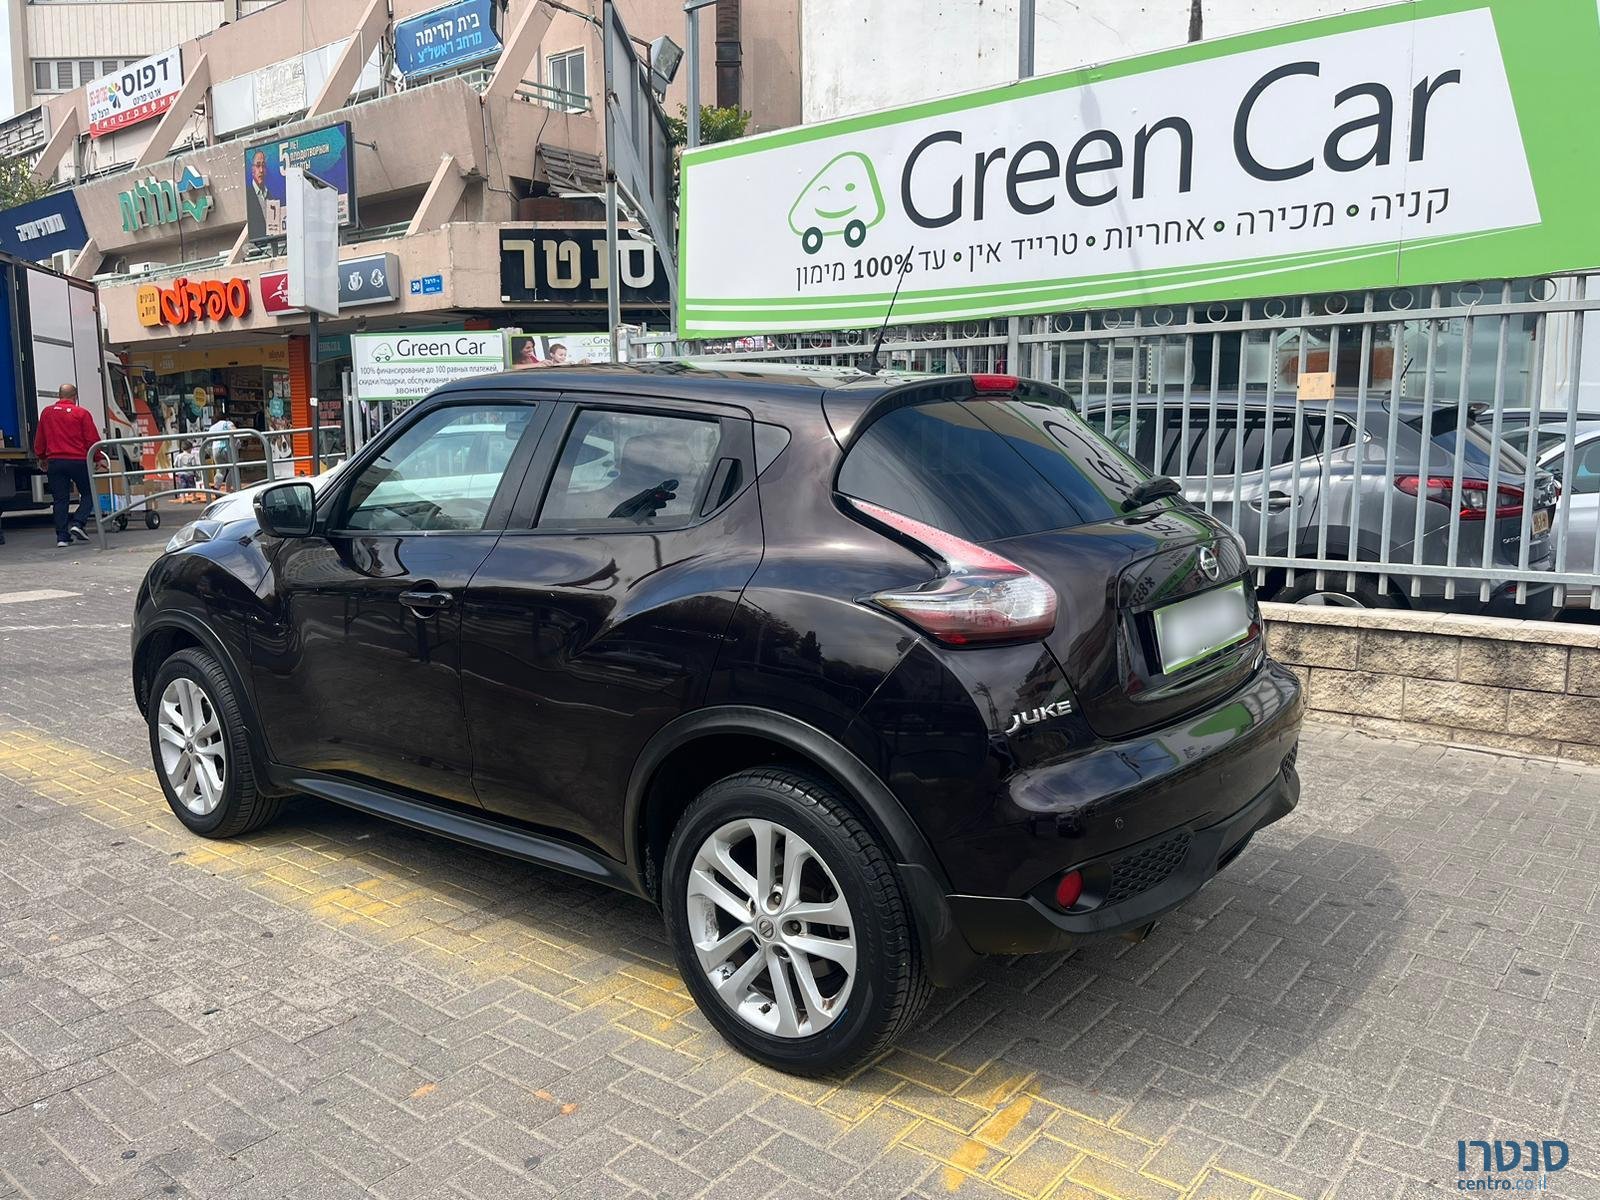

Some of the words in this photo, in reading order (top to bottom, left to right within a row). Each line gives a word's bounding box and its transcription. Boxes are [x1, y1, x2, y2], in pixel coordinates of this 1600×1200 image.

[416, 20, 453, 47] קדימה
[457, 12, 480, 33] בית
[456, 31, 482, 50] מרחב
[121, 57, 169, 97] דפוס
[901, 116, 1193, 229] Green
[1233, 61, 1461, 182] Car
[118, 176, 178, 233] כללית
[1236, 202, 1334, 236] מכירה
[1370, 187, 1449, 223] קניה
[1011, 232, 1078, 259] טרייד
[1103, 216, 1206, 251] אחריות
[502, 239, 655, 289] סנטר
[853, 253, 914, 280] 100%
[918, 249, 946, 270] עד
[968, 241, 1002, 272] אין
[412, 282, 420, 291] 30
[797, 260, 845, 291] מימון
[397, 339, 450, 357] Green
[455, 337, 486, 355] Car
[593, 336, 610, 344] Gre
[360, 367, 376, 375] 100%
[377, 366, 425, 375] финансирование
[435, 365, 445, 373] 100
[1005, 700, 1072, 737] JUKE
